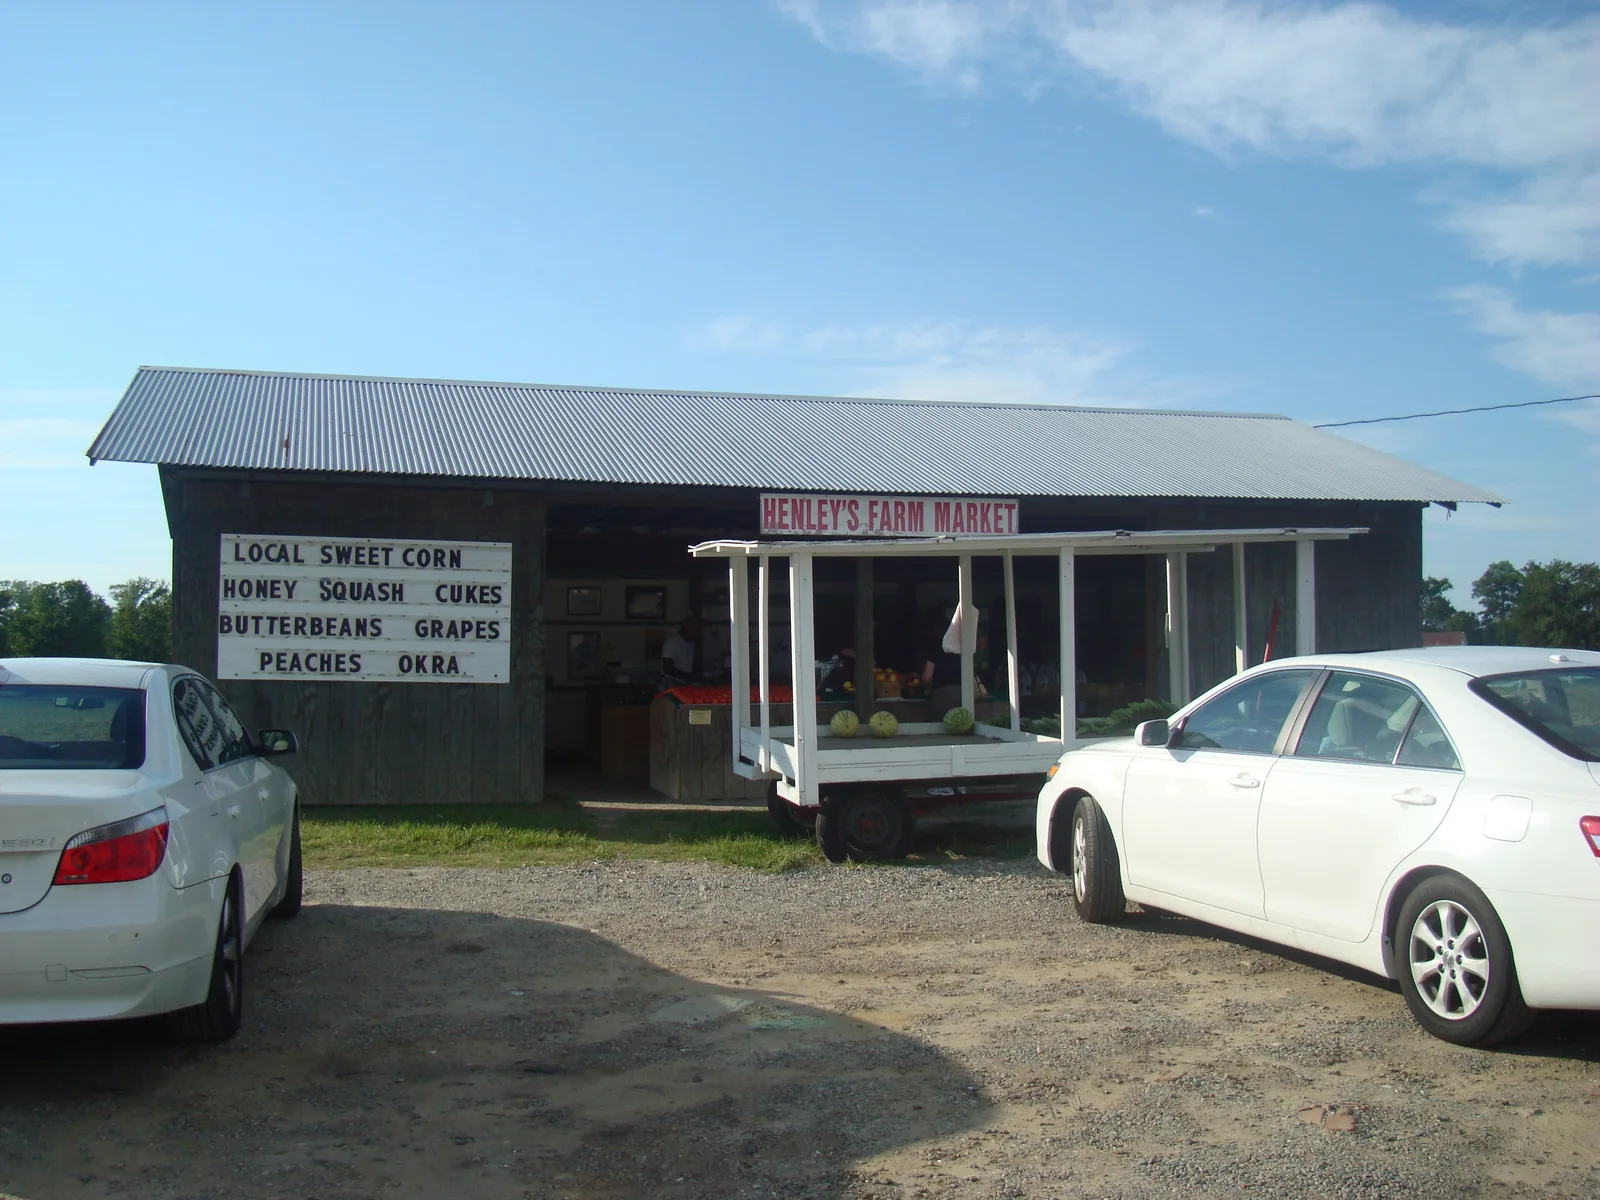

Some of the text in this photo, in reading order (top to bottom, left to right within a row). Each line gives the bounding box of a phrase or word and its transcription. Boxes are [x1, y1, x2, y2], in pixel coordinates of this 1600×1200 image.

[763, 497, 1016, 533] HENLEY'S FARM MARKET
[234, 542, 462, 569] LOCAL SWEET CORN
[223, 577, 503, 605] HONEY SQUASH CUKES
[219, 614, 501, 640] BUTTERBEANS GRAPES
[259, 651, 460, 675] PEACHES OKRA
